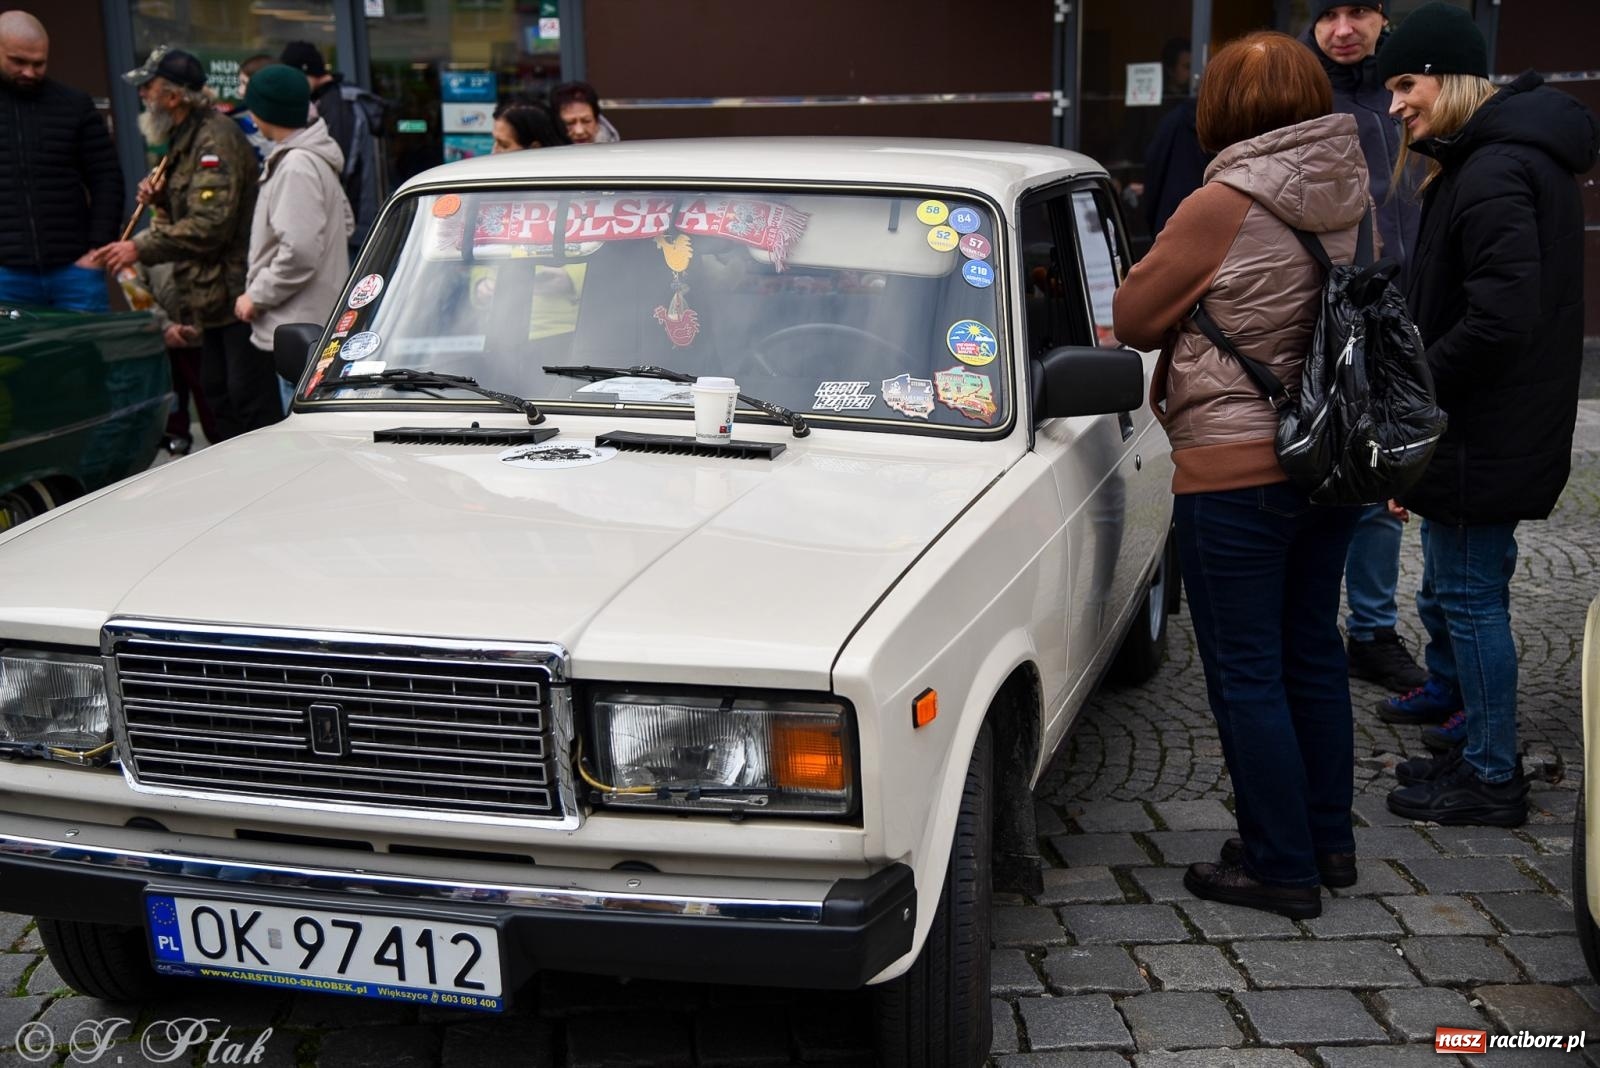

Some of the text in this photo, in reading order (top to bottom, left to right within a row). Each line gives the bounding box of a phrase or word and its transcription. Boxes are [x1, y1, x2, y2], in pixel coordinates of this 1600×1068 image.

[926, 205, 940, 214] 58
[518, 198, 709, 239] POLSKA
[957, 214, 971, 223] 84
[936, 231, 951, 240] 52
[969, 238, 984, 248] 57
[158, 936, 179, 951] PL
[191, 906, 486, 990] OK 97412
[200, 969, 368, 994] www.CARSTUDIO-SKROBEK.pl
[378, 986, 429, 1000] Większyce
[441, 993, 458, 1003] 603
[460, 996, 478, 1006] 898
[479, 998, 497, 1008] 400
